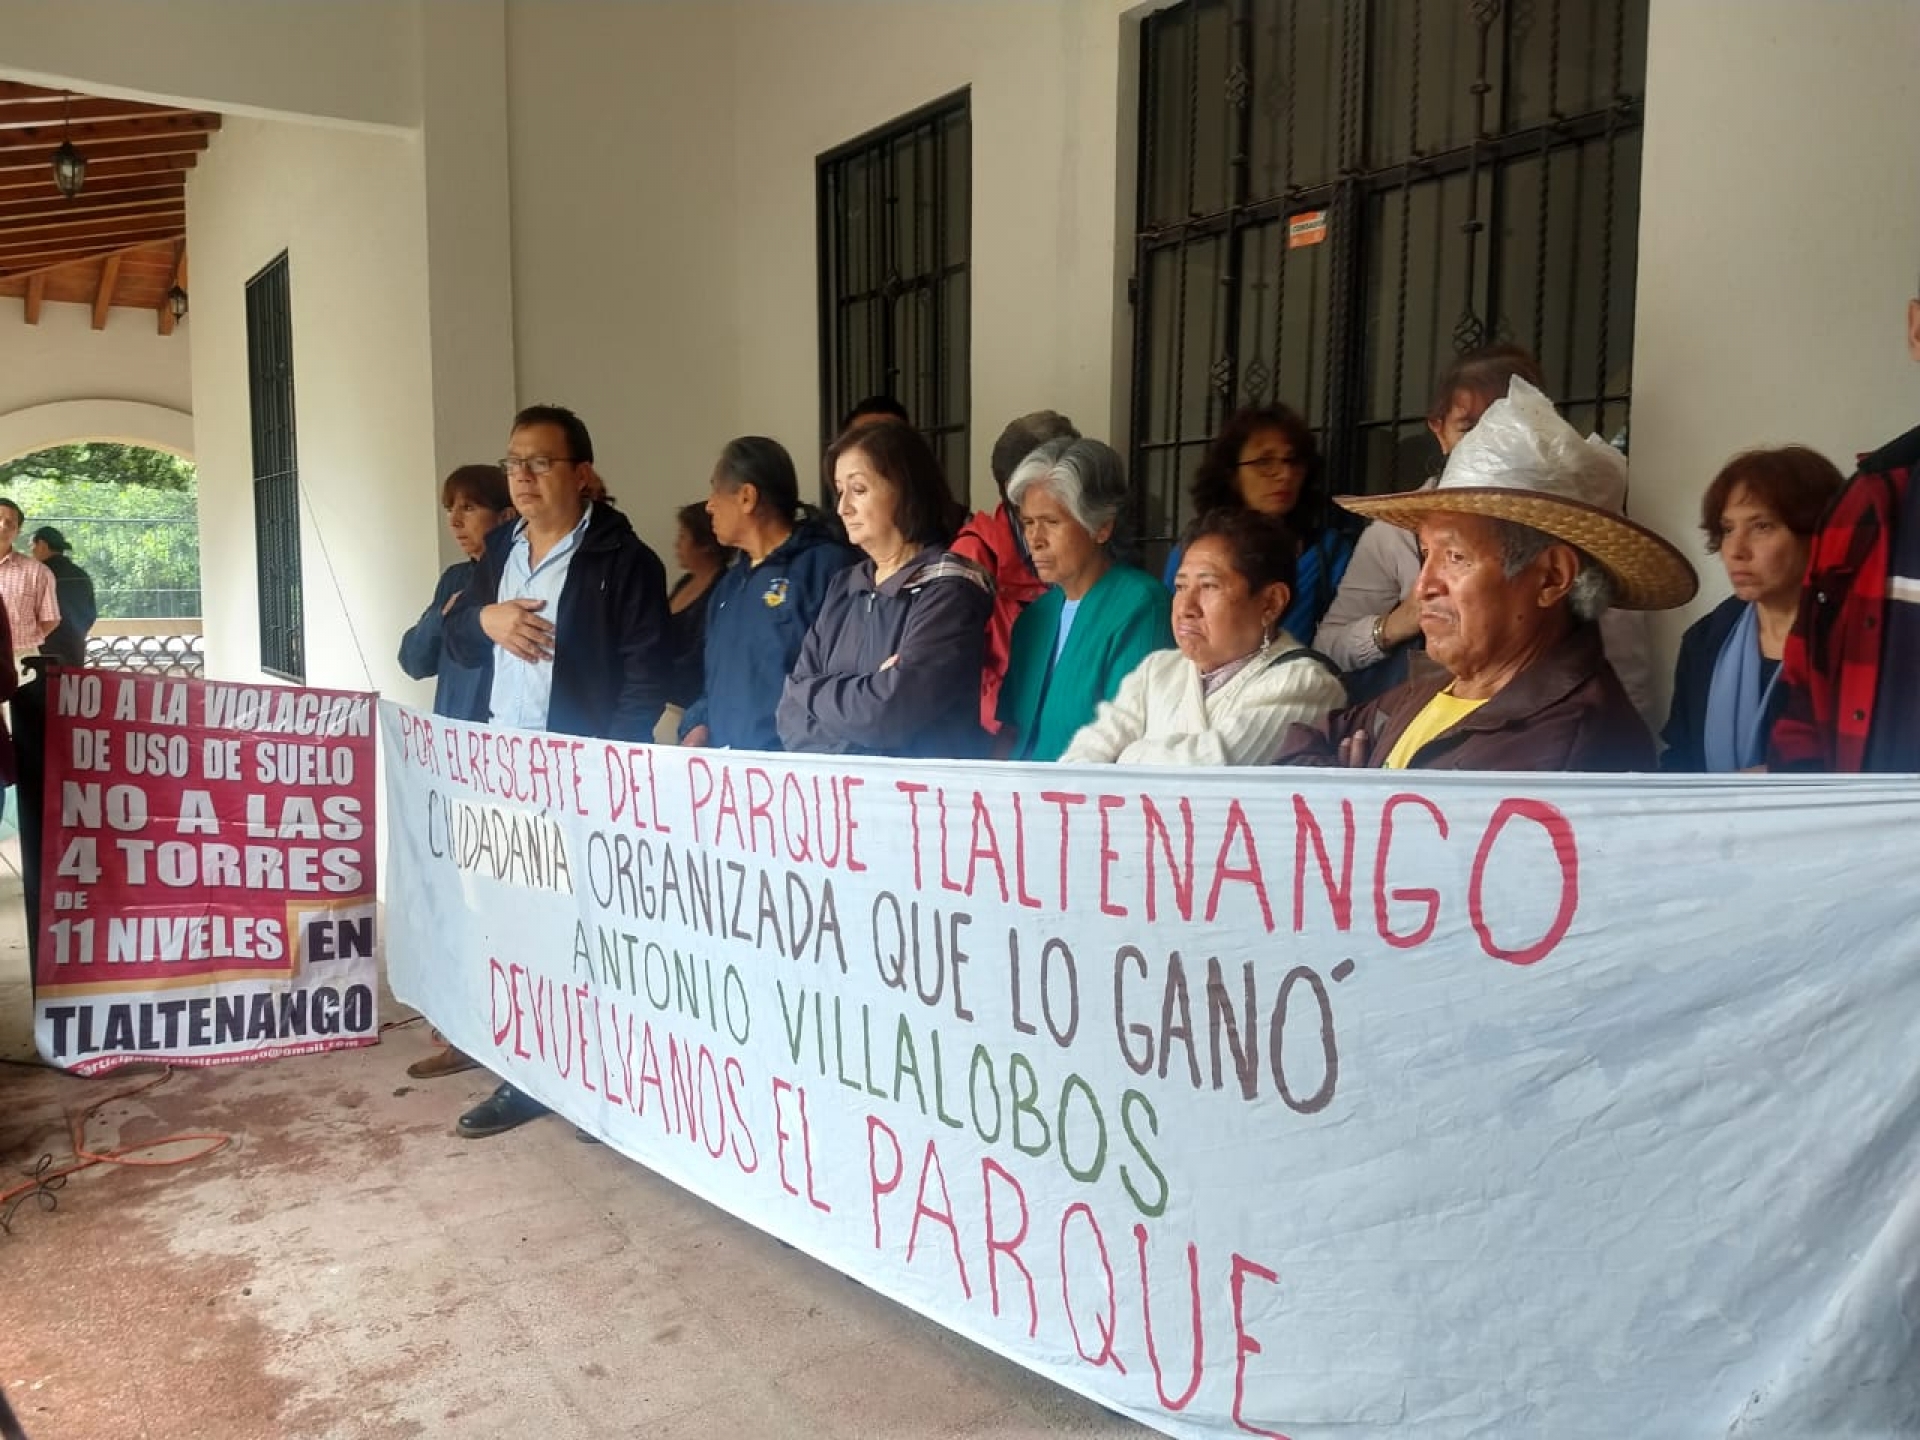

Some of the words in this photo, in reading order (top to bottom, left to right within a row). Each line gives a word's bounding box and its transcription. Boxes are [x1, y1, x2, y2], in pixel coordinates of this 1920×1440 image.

[58, 675, 101, 718] NO
[114, 680, 137, 722] A
[150, 681, 188, 727] LA
[72, 728, 111, 772] DE
[125, 732, 190, 778] USO
[203, 738, 242, 781] DE
[256, 742, 354, 786] SUELO
[61, 781, 147, 832] NO
[176, 790, 220, 835] A
[246, 794, 364, 841] LAS
[399, 708, 441, 777] POR
[444, 728, 469, 784] EL
[468, 731, 589, 816] RESCATE
[604, 744, 671, 834] DEL
[687, 756, 867, 872] PARQUE
[897, 781, 1579, 965] TLALTENANGO
[56, 837, 102, 884] 4
[116, 839, 363, 892] TORRES
[54, 891, 88, 910] DE
[48, 919, 96, 965] 11
[107, 917, 284, 963] NIVELES
[308, 917, 373, 962] EN
[587, 830, 848, 974] ORGANIZADA
[872, 890, 974, 1022] QUE
[1008, 927, 1080, 1048] LO
[44, 984, 374, 1058] TLALTENANGO
[573, 918, 751, 1046] ANTONIO
[776, 978, 1169, 1218] VILLALOBOS
[772, 1075, 832, 1213] EL
[866, 1113, 1294, 1440] PARQUE
